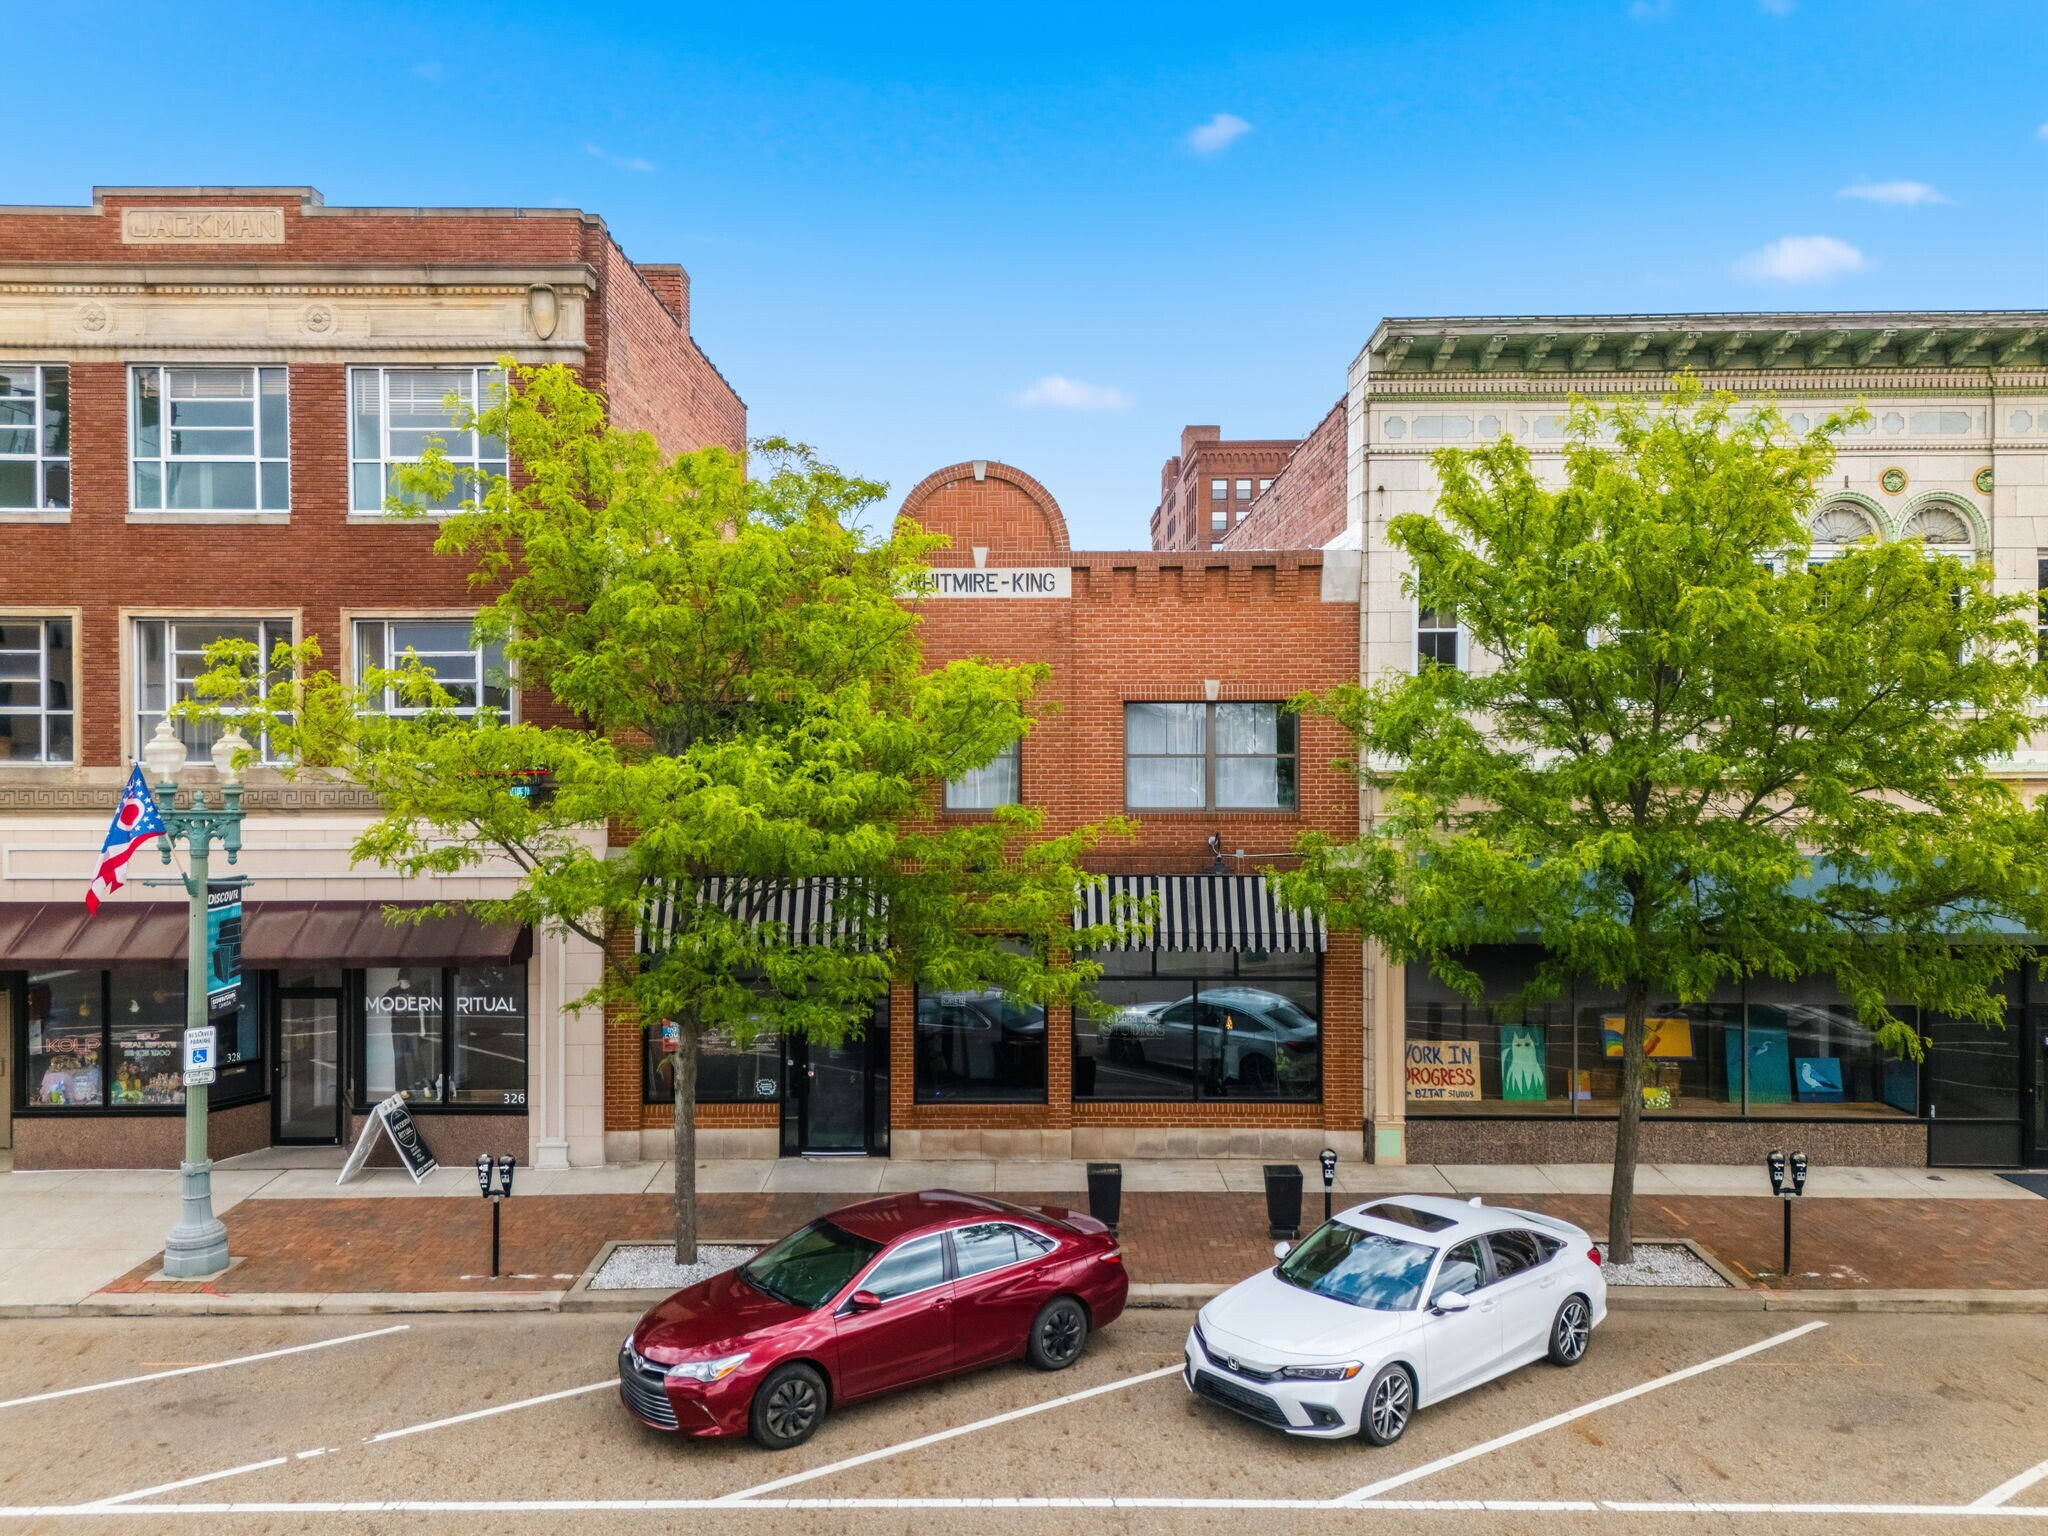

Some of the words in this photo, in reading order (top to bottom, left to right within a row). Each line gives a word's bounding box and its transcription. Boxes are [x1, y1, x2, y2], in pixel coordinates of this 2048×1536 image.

[131, 214, 279, 238] JACKMAN
[365, 996, 442, 1014] MODERN
[456, 996, 516, 1014] RITUAL
[46, 1038, 100, 1053] KOLP
[226, 1051, 241, 1063] 328
[1448, 1045, 1471, 1064] IN
[503, 1093, 525, 1104] 326
